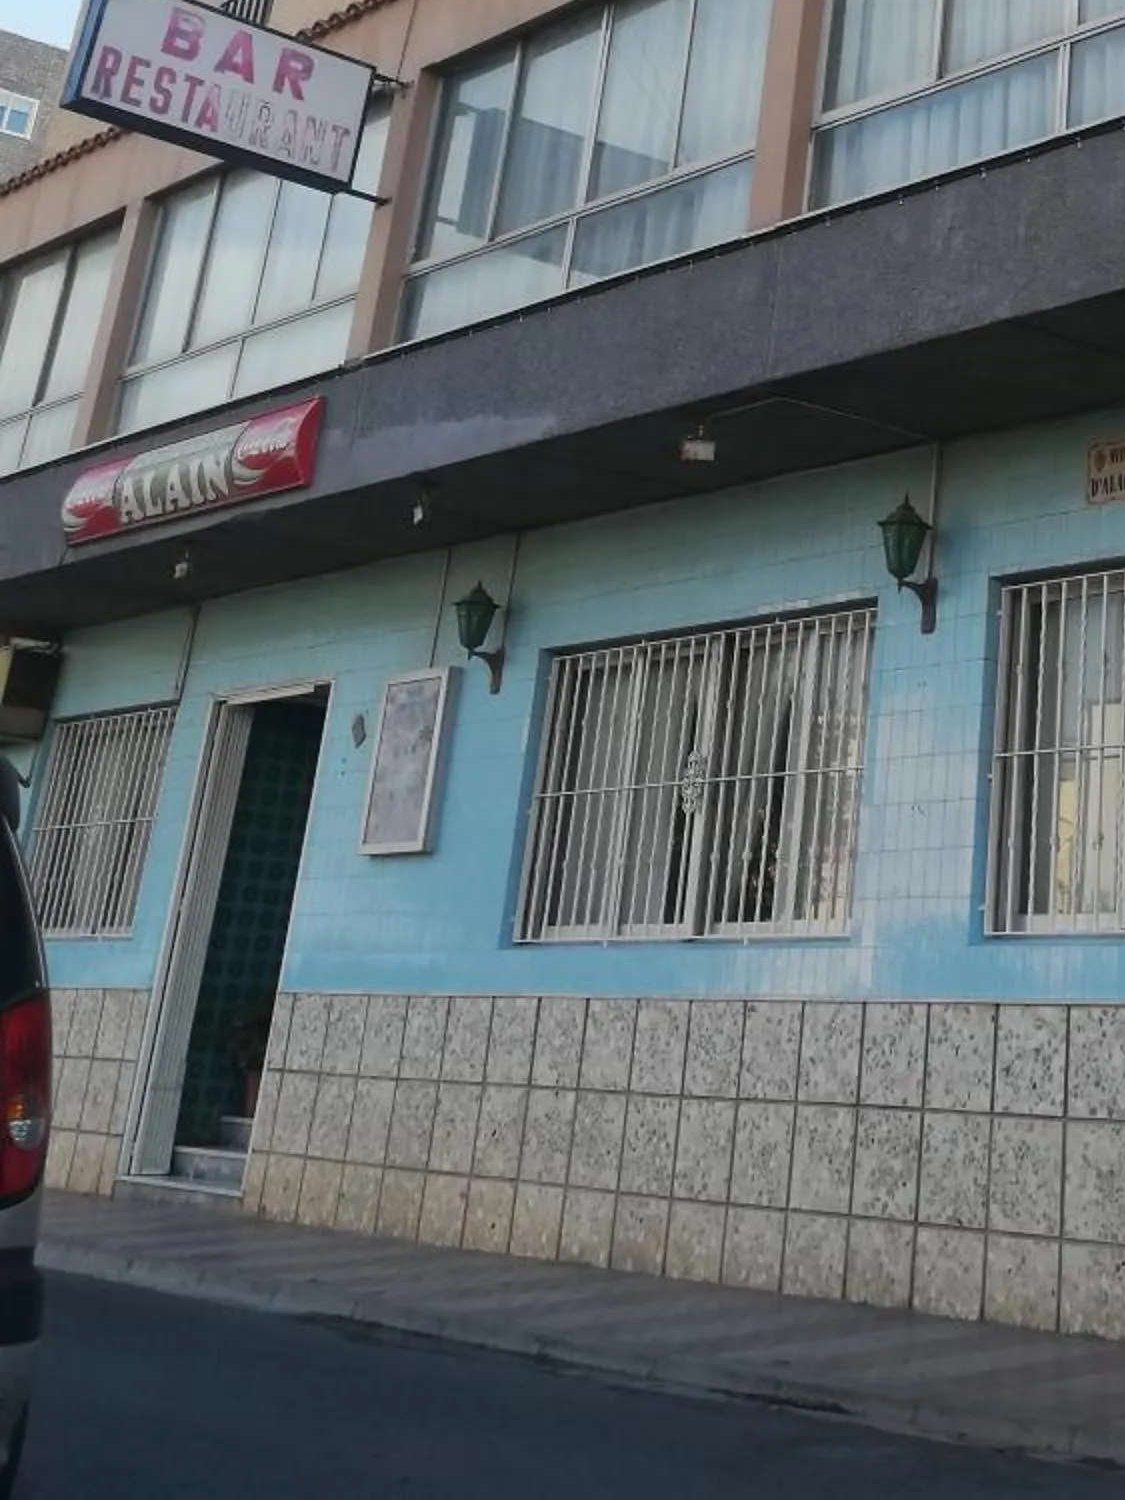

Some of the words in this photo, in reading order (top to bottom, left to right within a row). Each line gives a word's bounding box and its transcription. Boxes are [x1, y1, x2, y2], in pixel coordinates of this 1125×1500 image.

[161, 6, 315, 101] BAR
[91, 45, 350, 174] RESTAURANT
[119, 450, 232, 525] ALAIN
